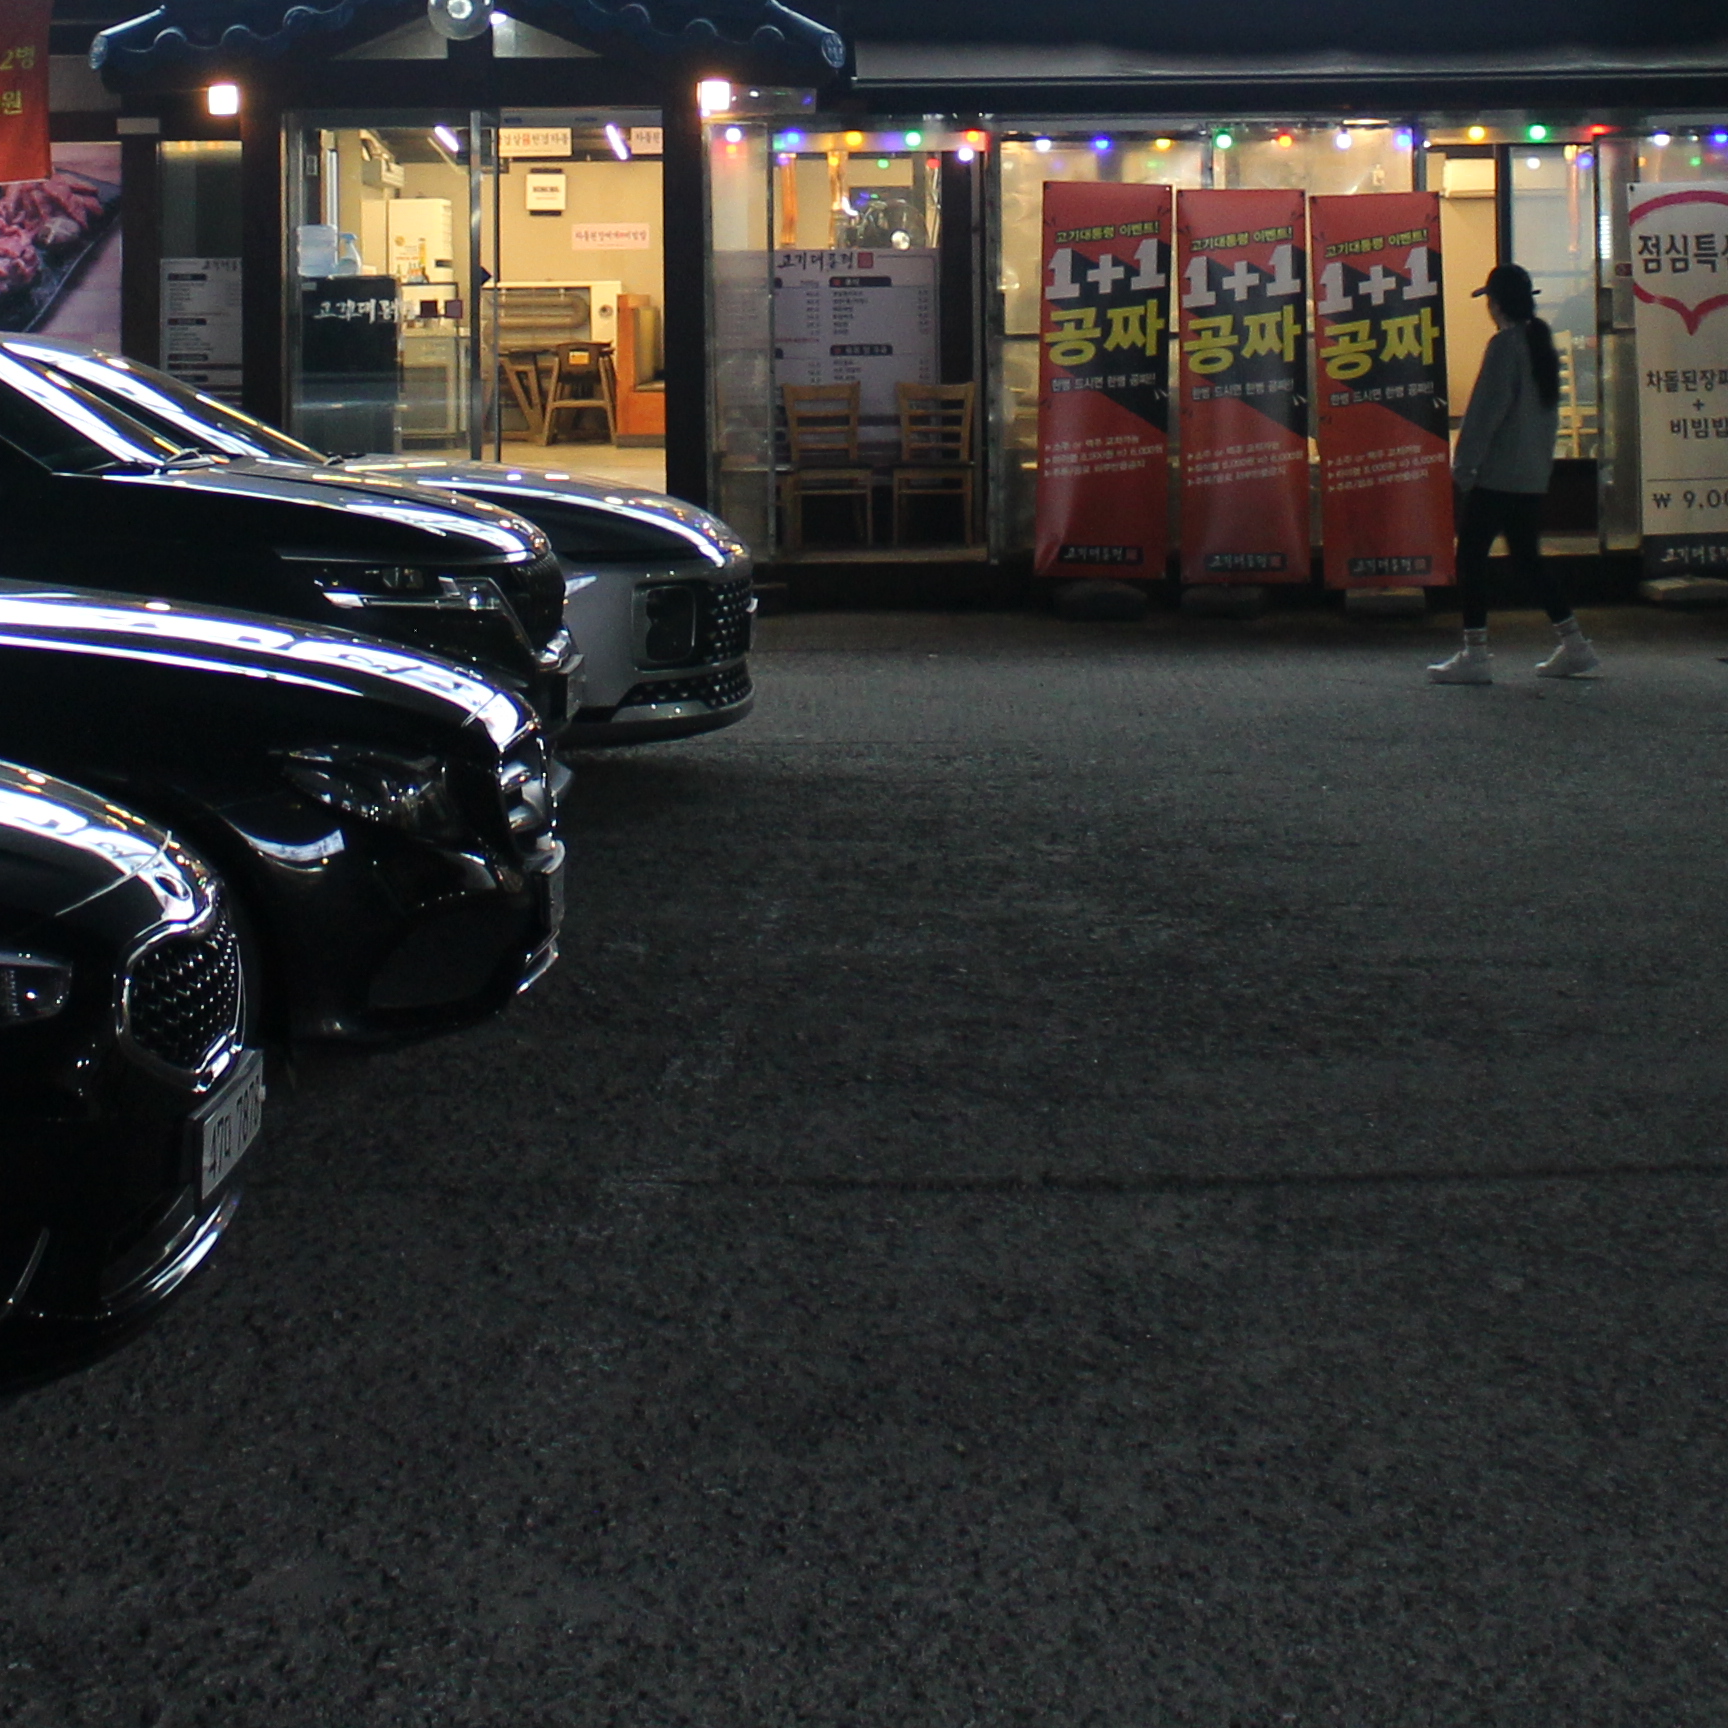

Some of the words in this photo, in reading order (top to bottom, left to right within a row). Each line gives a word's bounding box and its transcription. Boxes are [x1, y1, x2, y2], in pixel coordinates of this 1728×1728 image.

[0, 45, 36, 72] 2병
[1045, 238, 1166, 300] 1+1
[1182, 244, 1301, 308] 1+1
[1318, 247, 1438, 316] 1+1
[1044, 299, 1165, 366] 공짜
[1183, 304, 1302, 374] 공짜
[1320, 307, 1440, 380] 공짜
